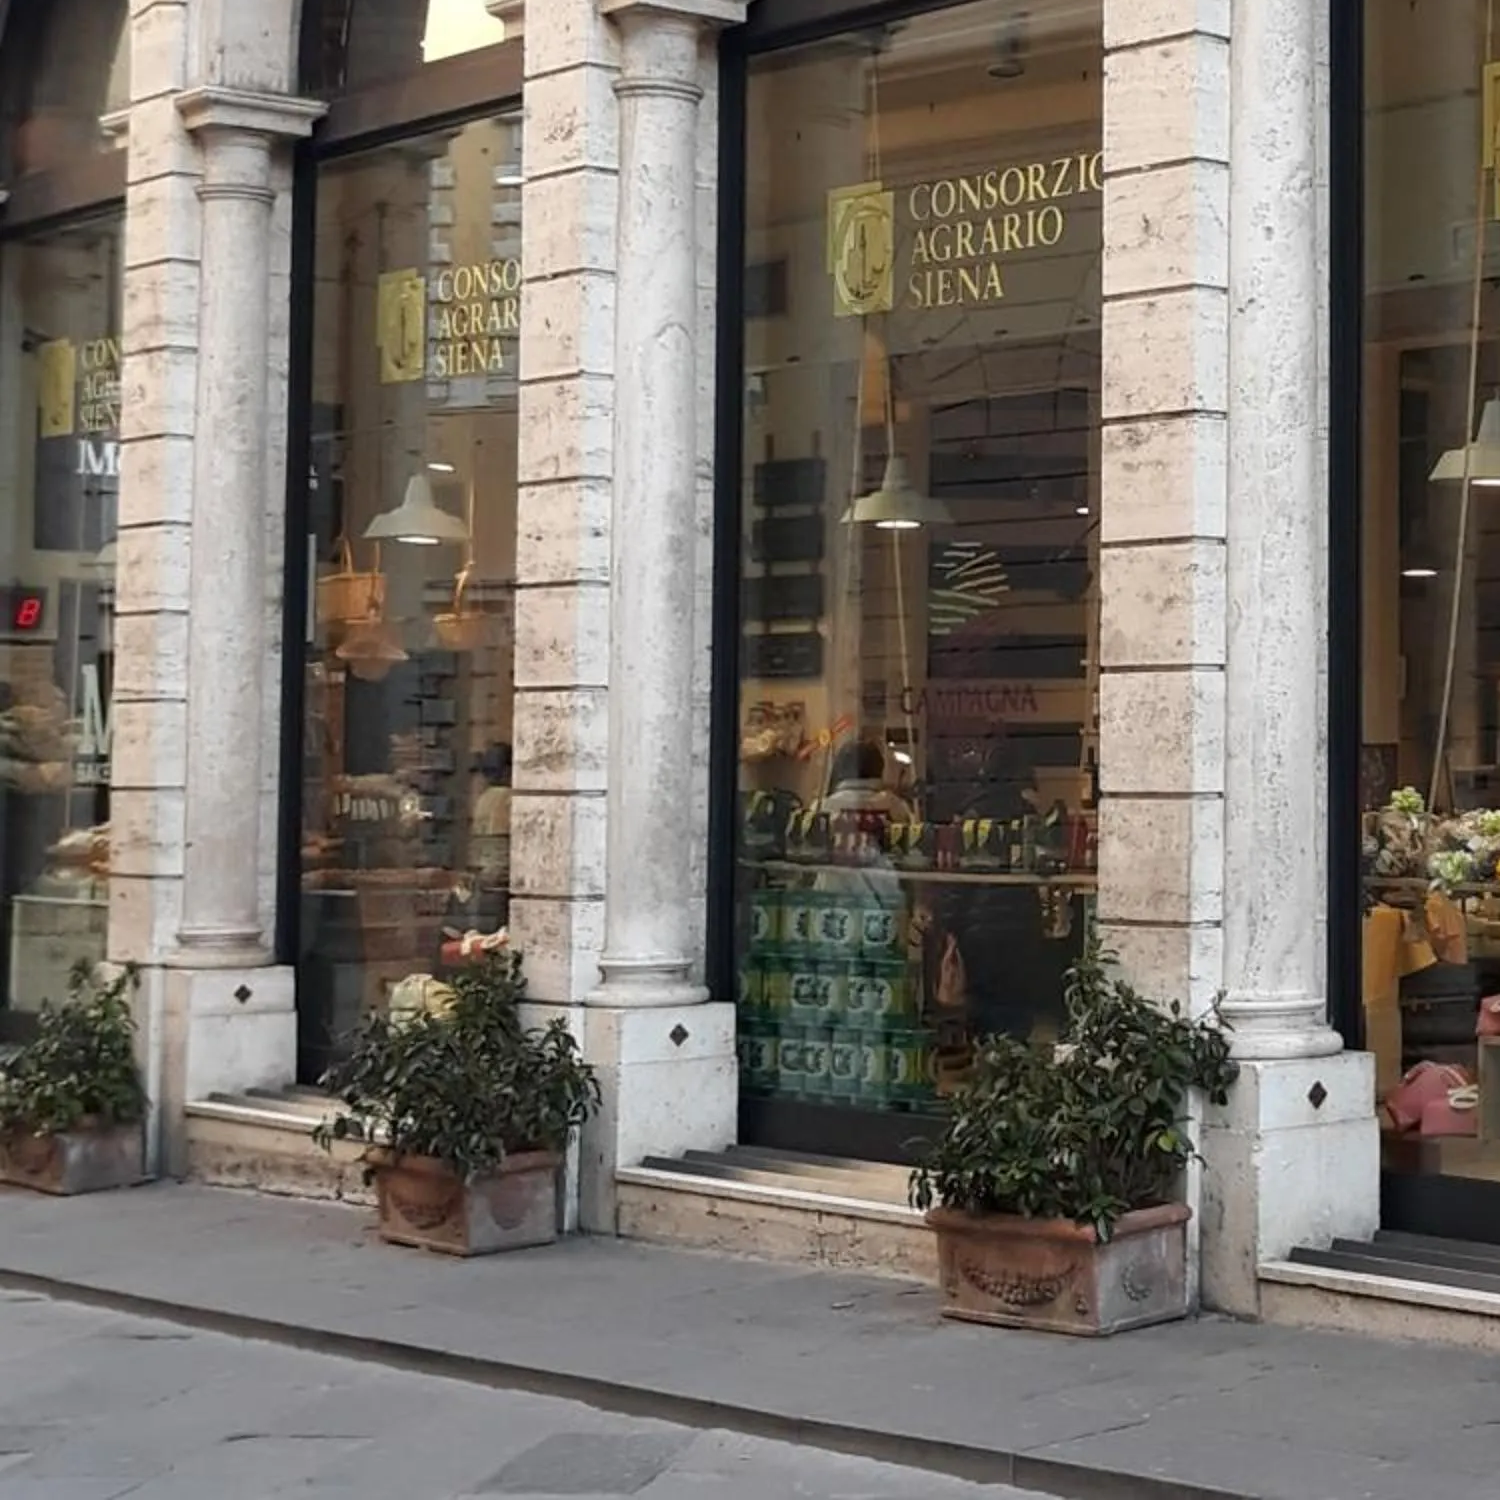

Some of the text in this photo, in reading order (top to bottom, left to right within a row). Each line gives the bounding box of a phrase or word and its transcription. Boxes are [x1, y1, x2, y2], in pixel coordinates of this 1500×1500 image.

[911, 205, 1064, 264] AGRARIO
[437, 258, 521, 302] CONSO
[909, 261, 1004, 308] SIENA
[438, 298, 520, 340] AGRAR
[435, 339, 503, 377] SIENA
[17, 599, 41, 625] 8
